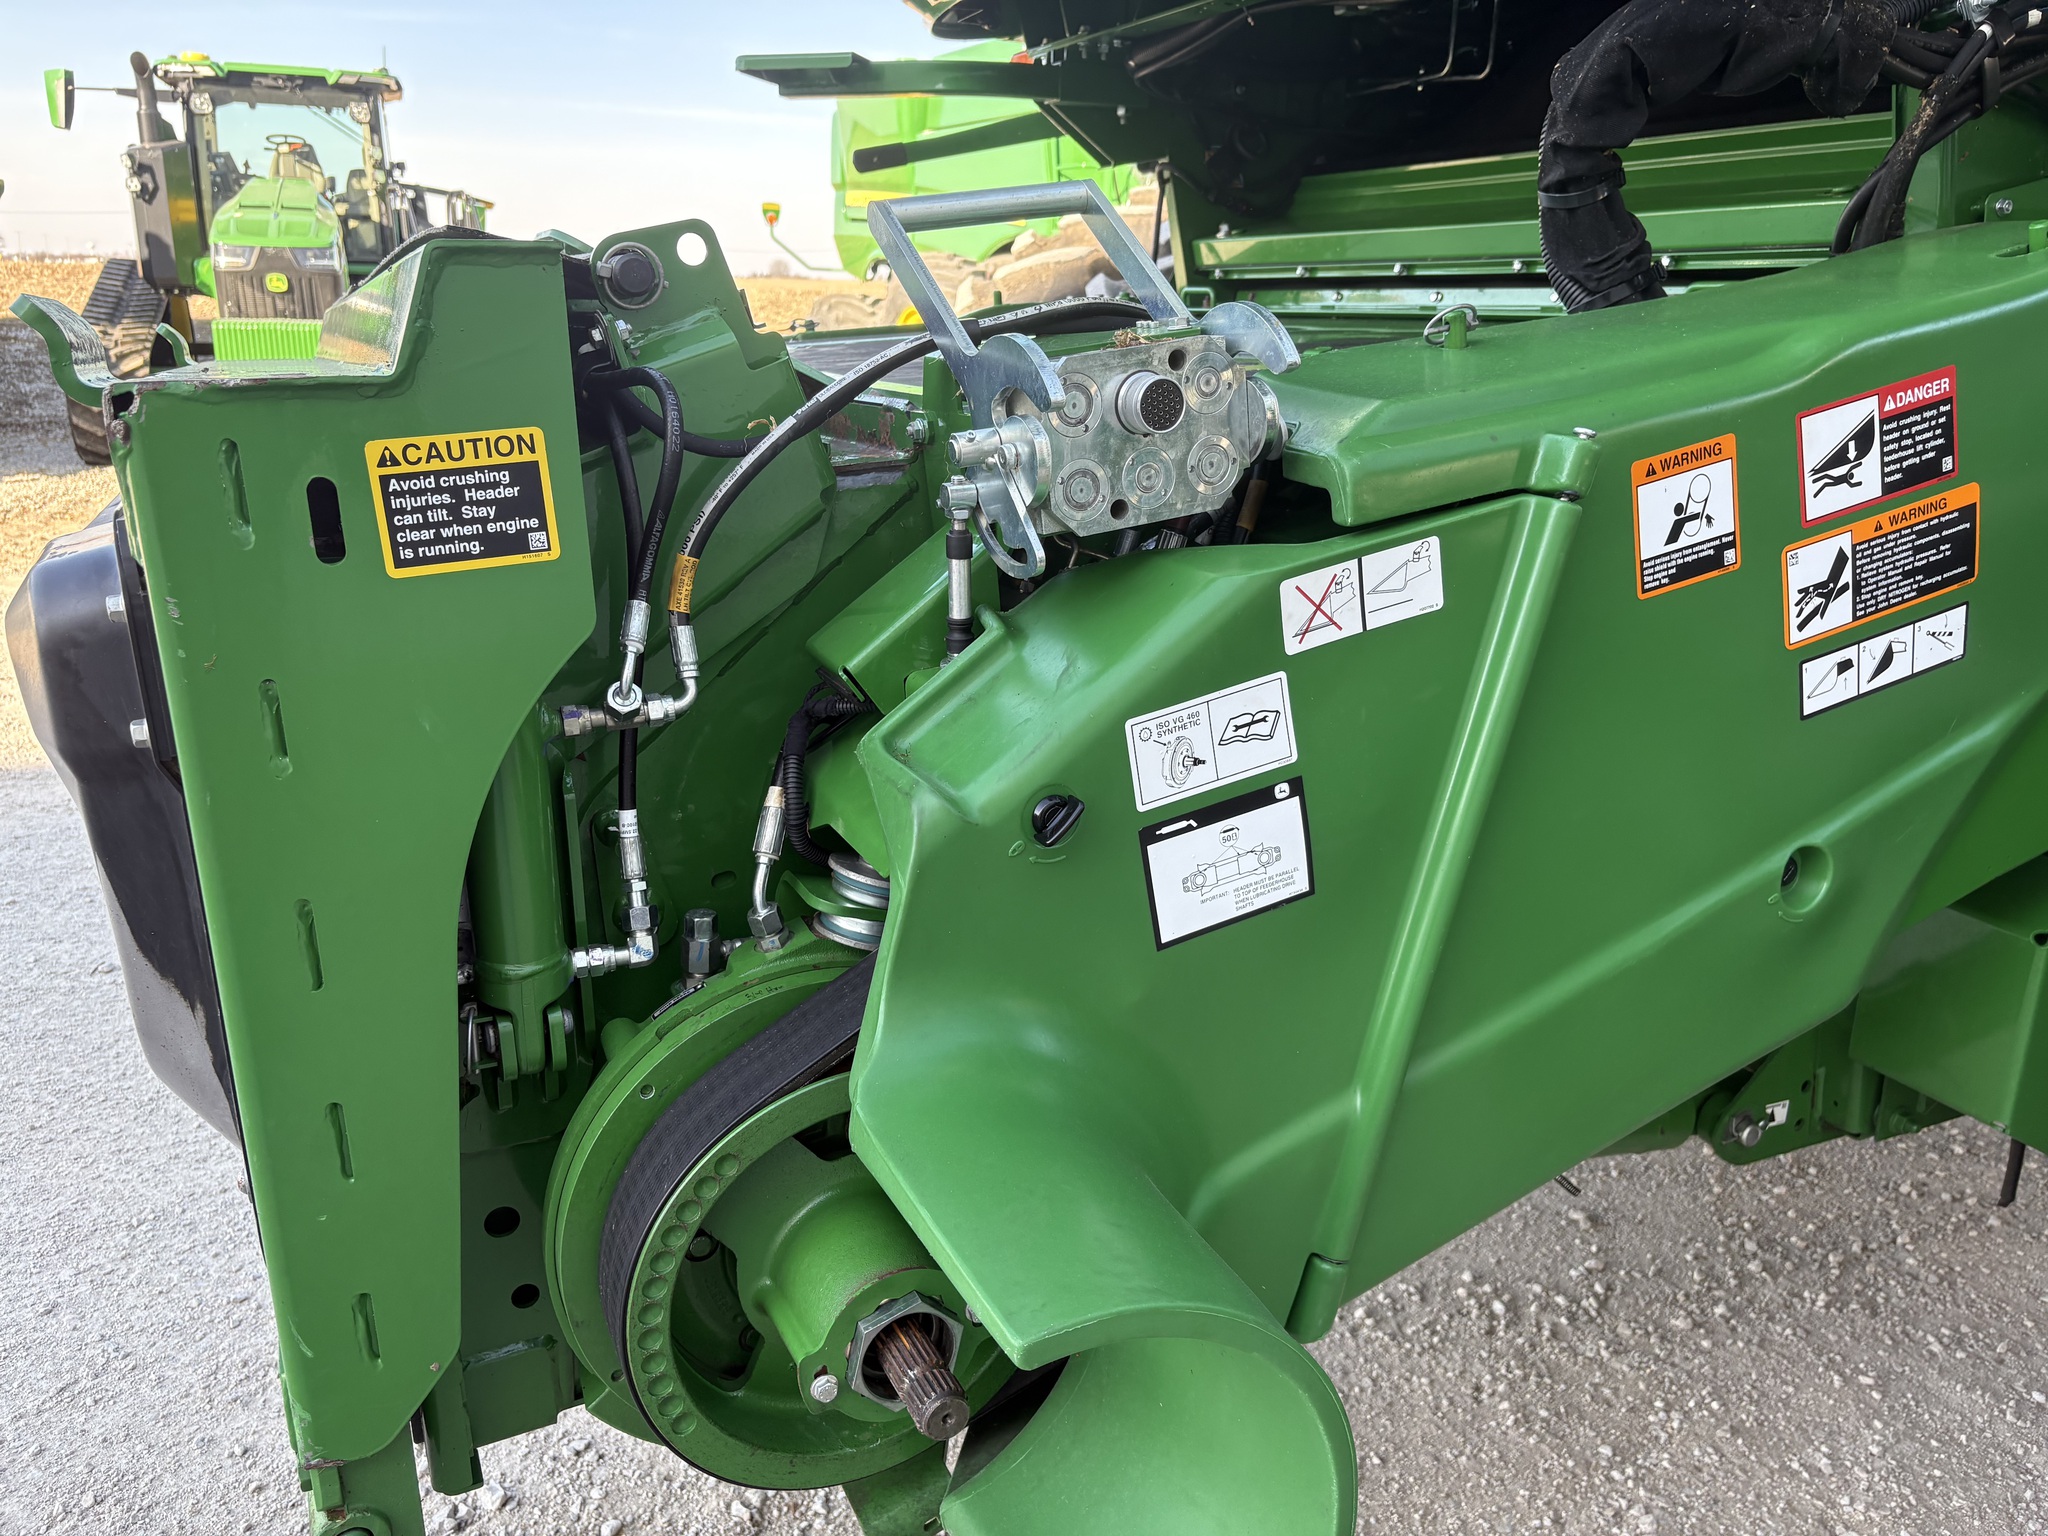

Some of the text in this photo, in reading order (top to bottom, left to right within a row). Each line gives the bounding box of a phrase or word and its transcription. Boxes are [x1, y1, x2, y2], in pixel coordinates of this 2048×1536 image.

[1896, 377, 1950, 408] DANGER
[1883, 421, 1897, 431] Avoid
[1899, 414, 1921, 425] crushing
[1940, 404, 1951, 412] Rest
[1883, 431, 1900, 441] header
[1911, 422, 1929, 433] ground
[1884, 443, 1898, 452] safety
[1915, 430, 1933, 441] located
[402, 433, 536, 465] CAUTION
[1660, 443, 1722, 472] WARNING
[1884, 448, 1914, 462] feederhouse
[1884, 451, 1936, 473] before getting under
[389, 470, 510, 492] Avoid crushing
[1885, 473, 1903, 483] header.
[391, 485, 520, 511] injuries. Header
[394, 505, 496, 526] can tilt. Stay
[1889, 498, 1947, 526] WARNING
[397, 517, 539, 543] clear when engine
[399, 540, 484, 559] is running.
[1643, 559, 1654, 568] Avoid
[1655, 556, 1670, 564] serious
[1671, 551, 1682, 560] injury
[1722, 535, 1733, 543] Never
[1872, 550, 1892, 560] removing
[1893, 542, 1912, 553] hydraulic
[1883, 541, 1895, 549] under
[1655, 563, 1667, 571] shield
[1684, 554, 1697, 562] engine
[1863, 560, 1882, 571] changing
[1879, 564, 1893, 573] system
[1895, 557, 1914, 567] hydraulic
[1644, 580, 1659, 589] remove
[1868, 573, 1886, 583] Operator
[1888, 567, 1903, 576] Manual
[1861, 584, 1876, 593] system
[1873, 587, 1887, 596] engine
[1898, 578, 1914, 587] remove
[1877, 594, 1886, 602] DRY
[1888, 585, 1911, 598] NITROGEN
[1866, 606, 1876, 614] your
[1156, 711, 1200, 730] ISO VG 460
[1157, 719, 1200, 738] SYNTHETIC
[1200, 890, 1230, 904] IMPORTANT:
[1233, 882, 1253, 893] HEADER
[1254, 877, 1267, 886] MUST
[1276, 867, 1299, 879] PARALLEL
[1242, 889, 1251, 897] TOP
[1260, 874, 1294, 890] FEEDERHOUSE
[1235, 897, 1249, 905] WHEN
[1250, 886, 1281, 900] LUBRICATING
[1236, 902, 1254, 911] SHAFTS
